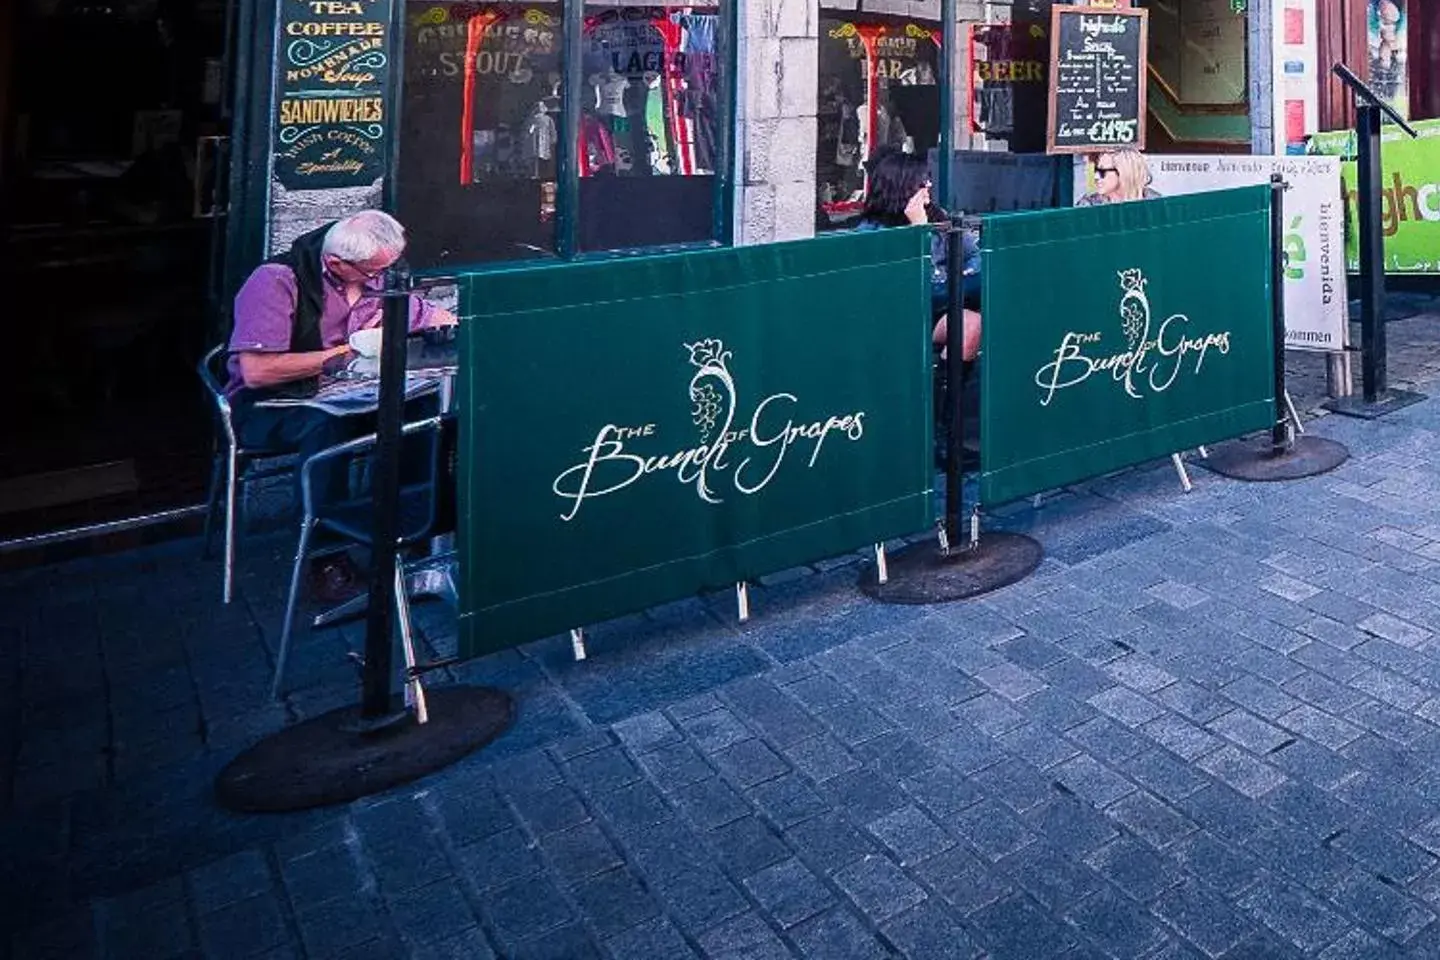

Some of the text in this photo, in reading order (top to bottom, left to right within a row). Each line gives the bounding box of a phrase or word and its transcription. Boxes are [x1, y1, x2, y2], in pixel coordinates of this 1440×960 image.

[308, 0, 364, 15] TEA
[286, 21, 385, 37] COFFEE
[319, 63, 376, 88] Soup
[279, 96, 384, 126] SANDWICHES
[1319, 201, 1335, 306] bienvenida
[1077, 331, 1102, 344] THE
[1149, 313, 1232, 392] Grapes
[1034, 331, 1147, 407] Bunch
[552, 392, 866, 522] THE Bunch OF Grapes
